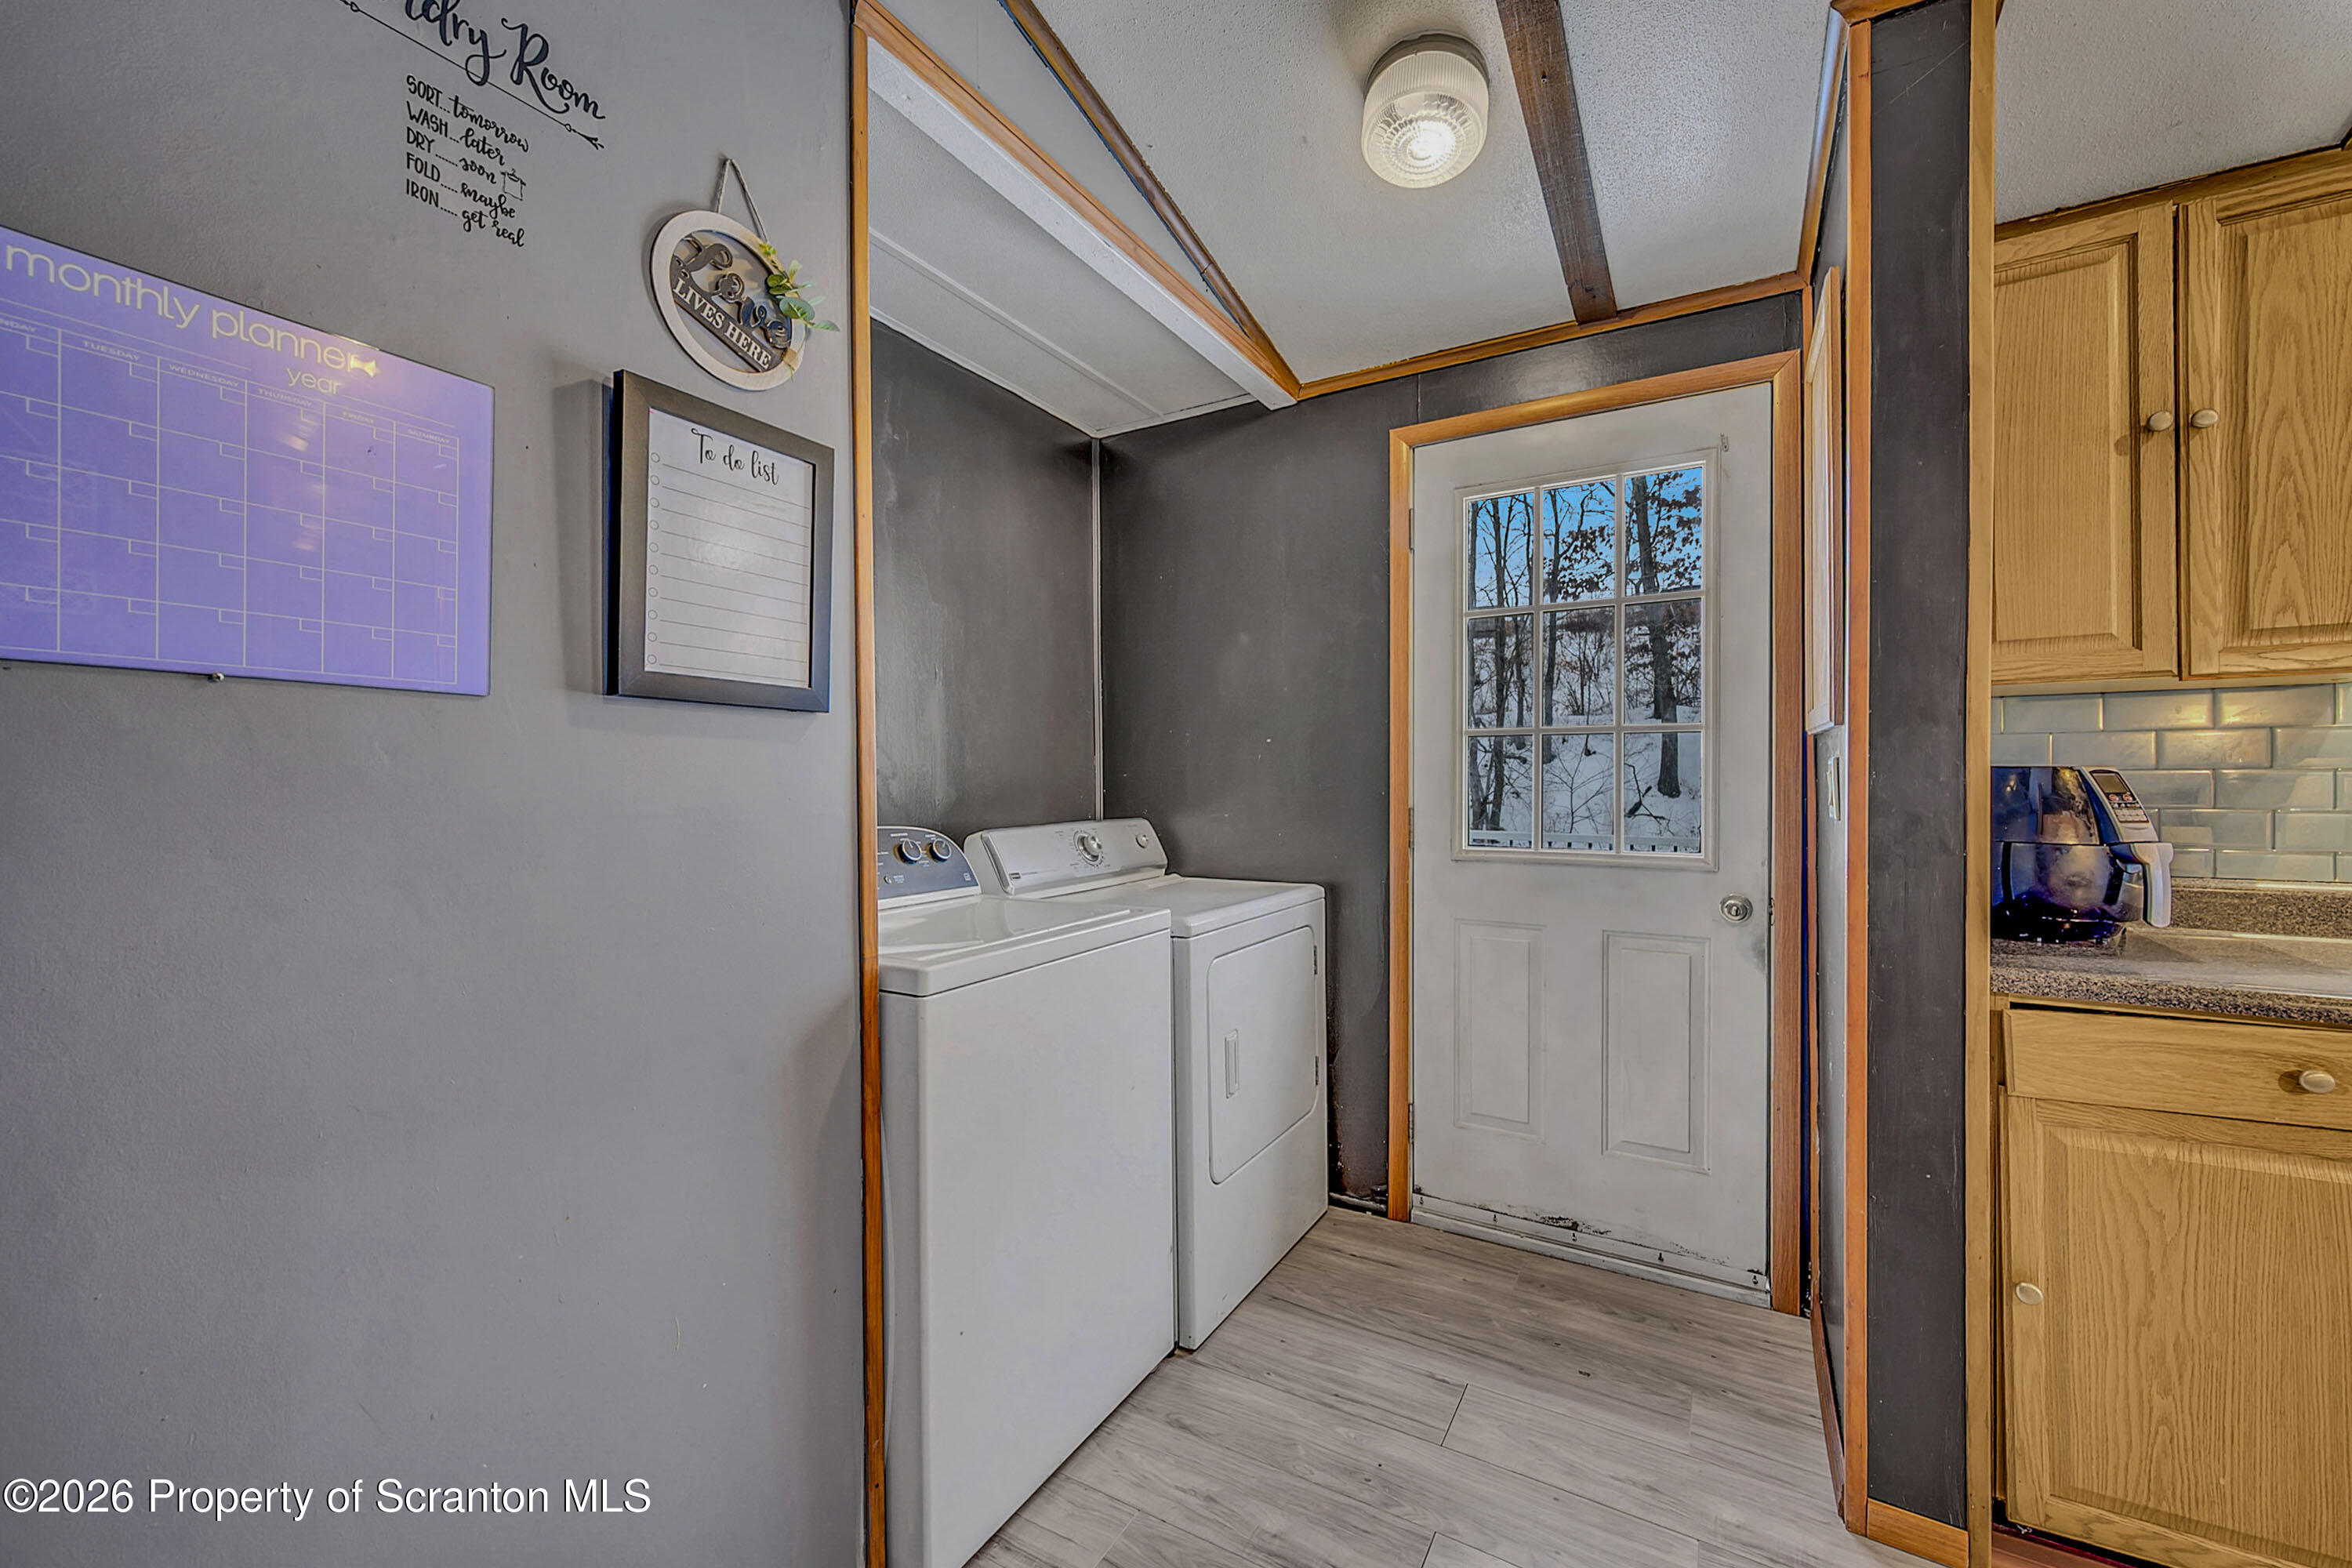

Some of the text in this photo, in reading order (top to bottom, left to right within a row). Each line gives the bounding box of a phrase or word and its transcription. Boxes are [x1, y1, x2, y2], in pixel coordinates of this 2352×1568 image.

[405, 0, 606, 120] dry Room
[448, 95, 529, 152] tomorrow
[459, 128, 506, 165] later
[459, 158, 497, 184] soon
[460, 182, 516, 220] maybe
[462, 210, 488, 232] get
[492, 220, 525, 247] real
[5, 245, 201, 328] monthly
[673, 278, 772, 369] LIVES HERE
[82, 339, 140, 361] TUESDAY
[169, 364, 240, 387] WEDNESDAY
[257, 388, 312, 407] THURSDAY
[286, 367, 342, 395] year
[691, 428, 780, 485] To do list
